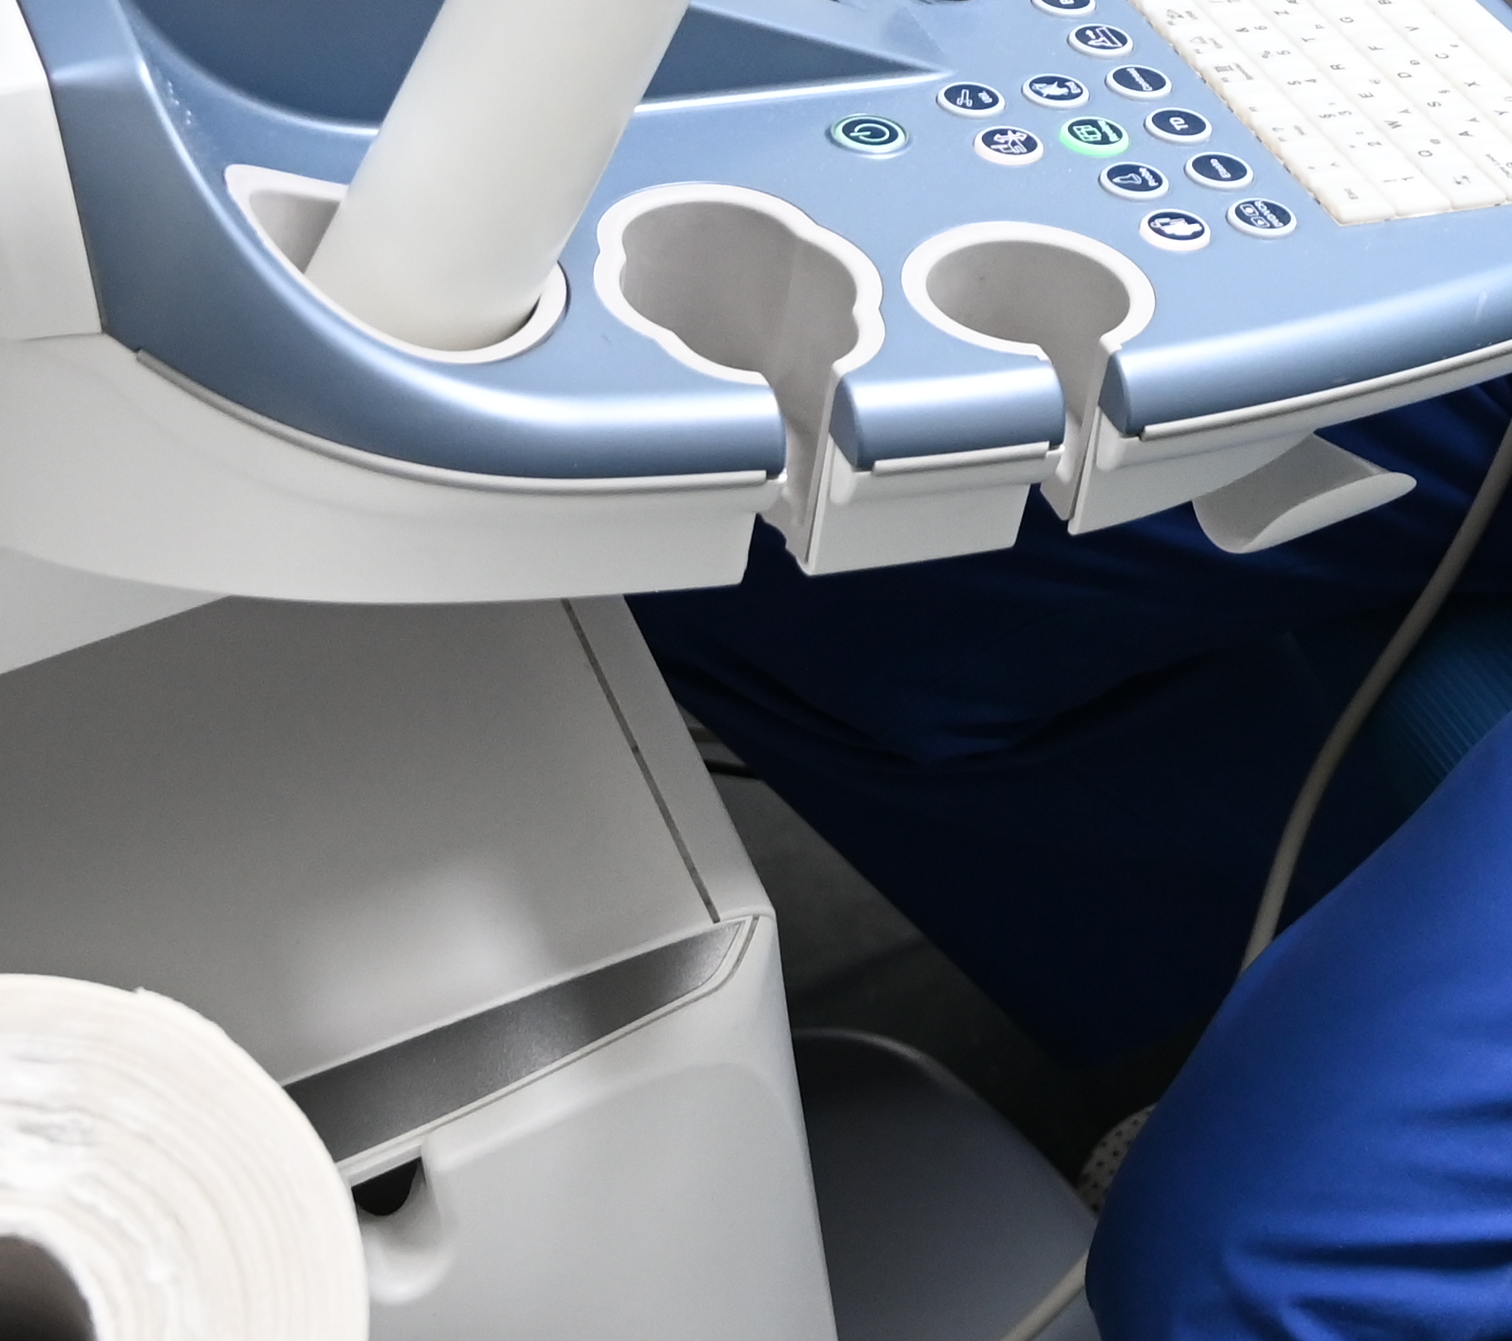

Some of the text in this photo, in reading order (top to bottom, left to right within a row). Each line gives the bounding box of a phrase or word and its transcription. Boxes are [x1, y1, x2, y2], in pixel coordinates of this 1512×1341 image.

[1272, 8, 1291, 16] Z
[1337, 14, 1355, 24] G
[1403, 24, 1420, 33] V
[1299, 35, 1316, 44] T
[1366, 44, 1384, 52] F
[1433, 51, 1450, 60] C
[1328, 62, 1346, 71] R
[1395, 70, 1413, 79] D
[1463, 79, 1479, 88] X
[1356, 90, 1375, 99] E
[1425, 99, 1443, 108] S
[1493, 108, 1509, 117] Y
[1169, 116, 1189, 131] TD
[1383, 118, 1403, 130] W
[1456, 128, 1474, 138] A
[1416, 148, 1434, 158] Q
[1138, 166, 1159, 188] Probe
